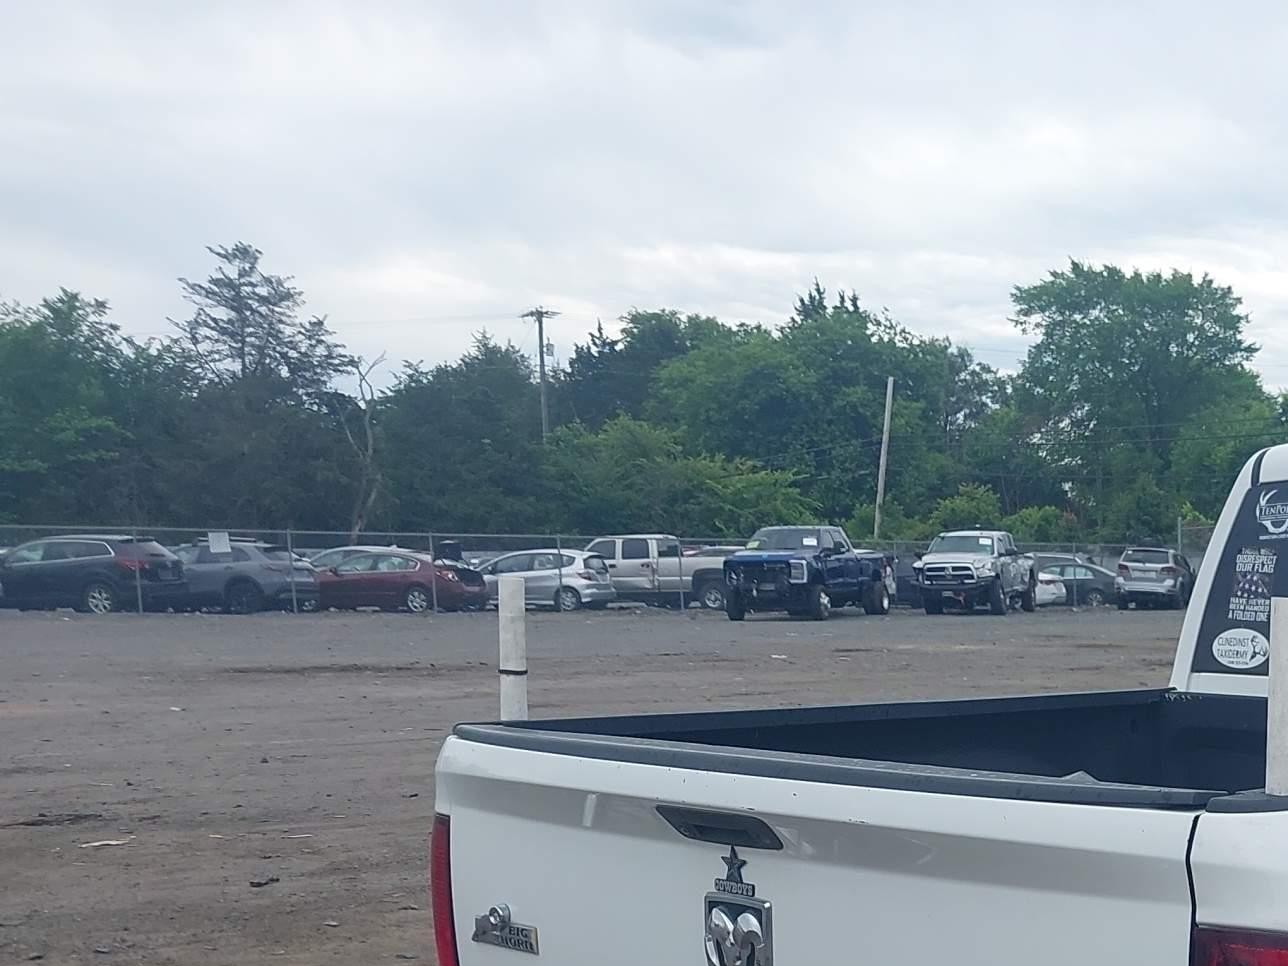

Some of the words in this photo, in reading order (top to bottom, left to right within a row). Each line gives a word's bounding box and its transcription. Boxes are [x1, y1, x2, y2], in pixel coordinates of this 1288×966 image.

[1236, 554, 1277, 565] DISRESPECT
[1236, 563, 1253, 572] OUR
[1254, 563, 1274, 573] FLAG
[1228, 610, 1233, 619] A
[1234, 610, 1256, 621] FOLDED
[1256, 612, 1269, 622] ONE
[715, 879, 753, 897] COWBOYS
[508, 926, 529, 939] BIG
[501, 935, 535, 952] HORN
